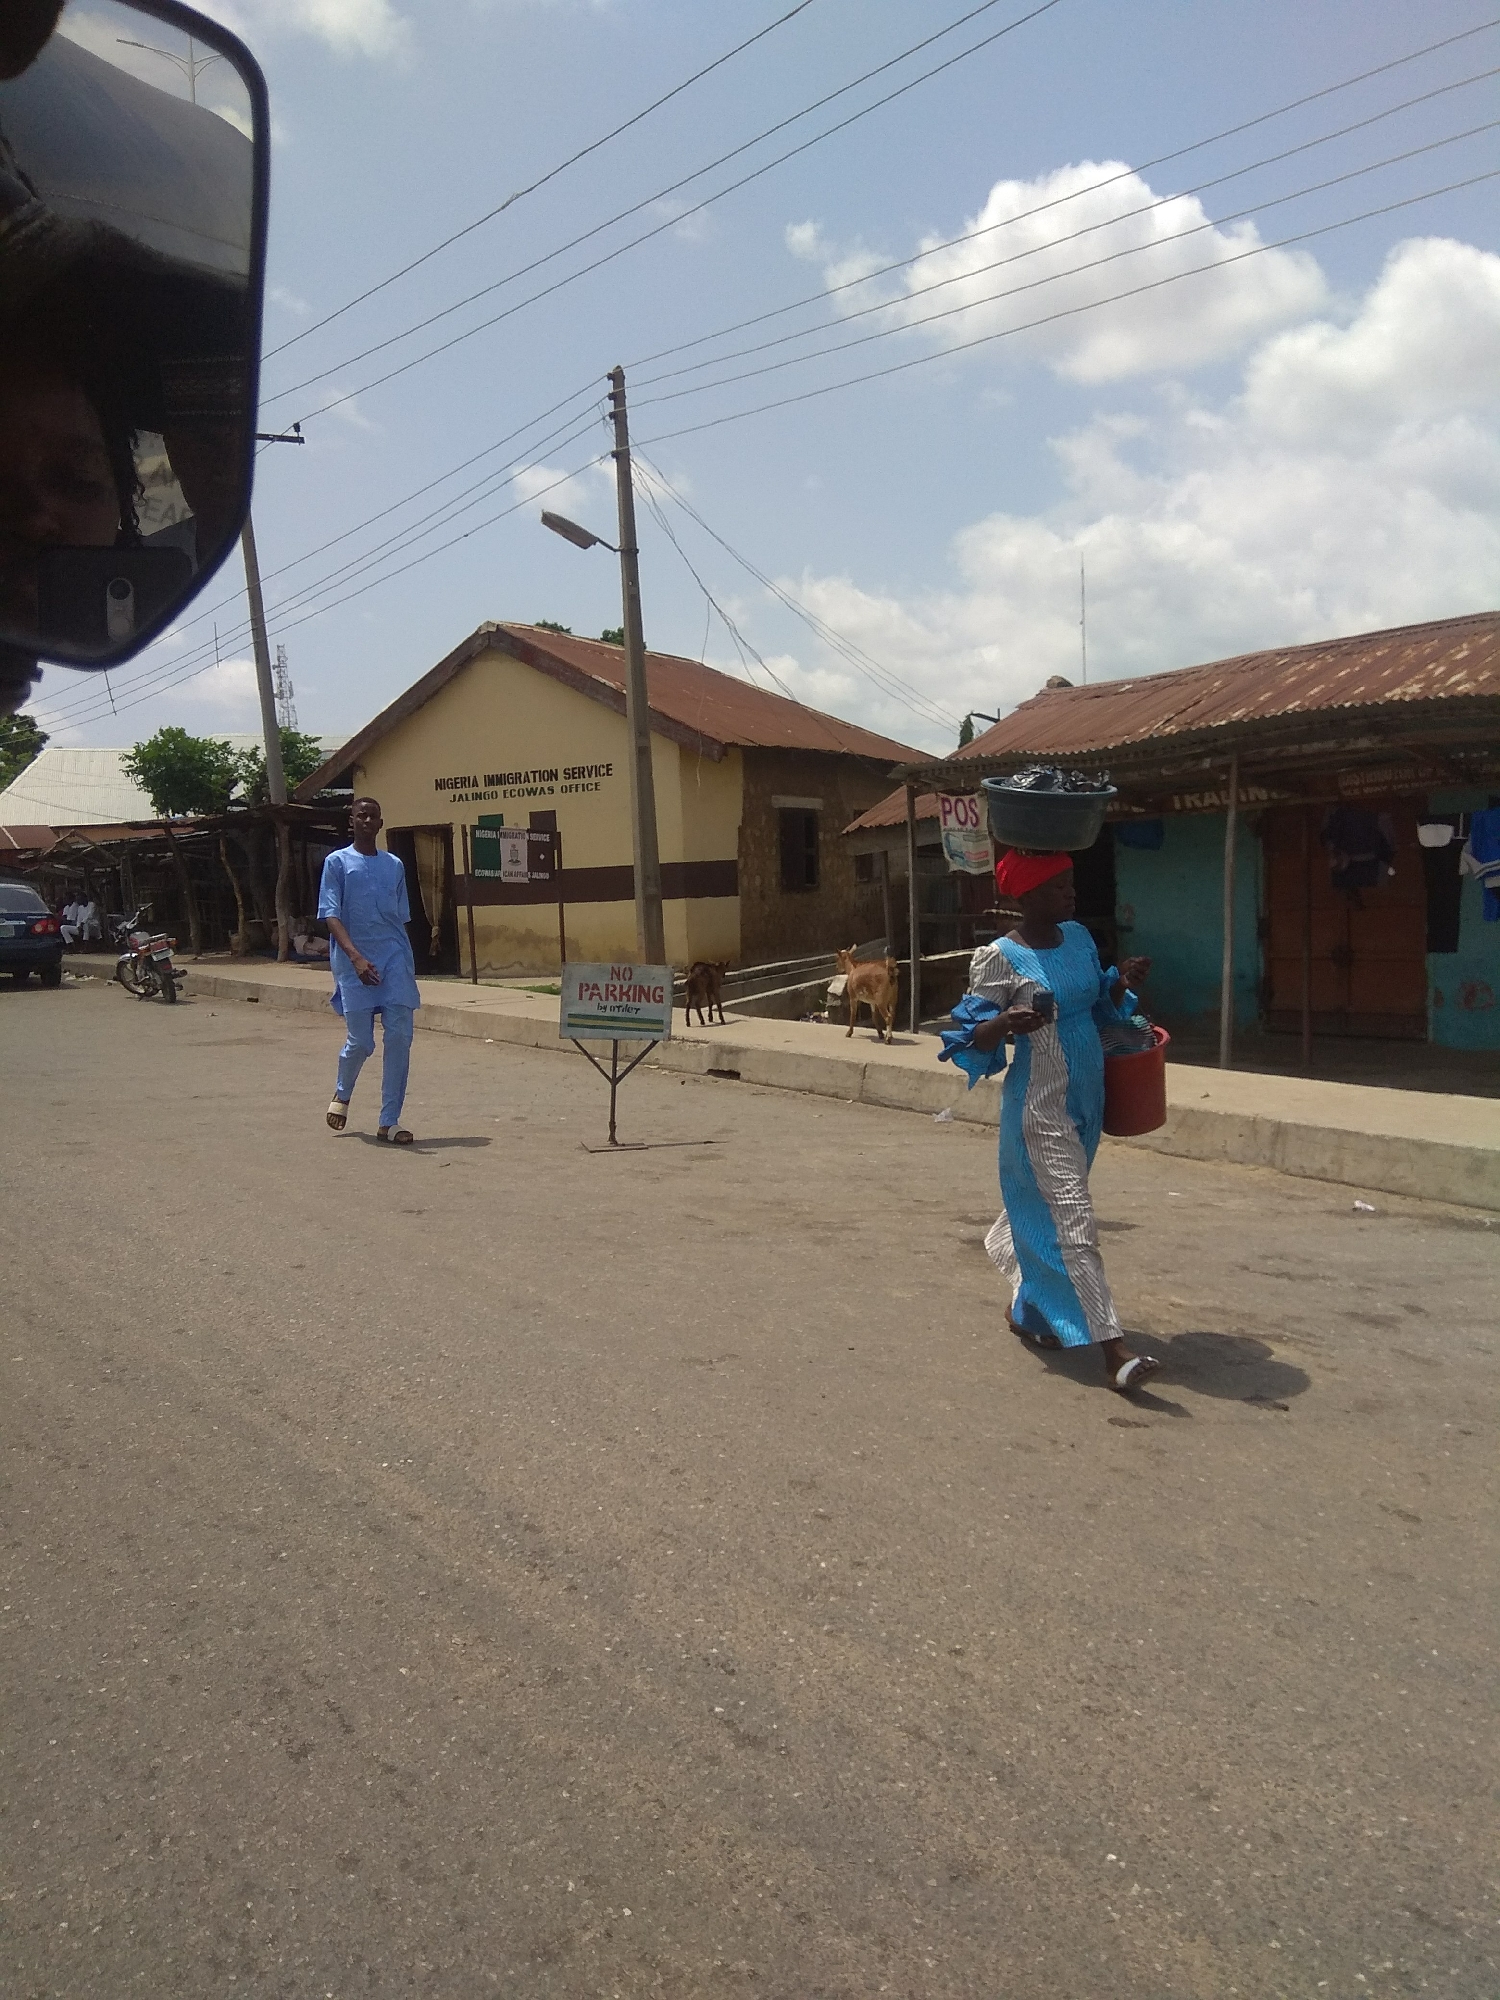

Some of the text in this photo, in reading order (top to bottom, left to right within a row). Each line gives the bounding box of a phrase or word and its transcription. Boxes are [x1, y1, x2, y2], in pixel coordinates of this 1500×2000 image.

[434, 763, 613, 791] NIGERIA IMMIGRATION SERVICE
[449, 781, 601, 803] JALINGO ECOWAS OFFICE
[940, 797, 979, 828] POS
[475, 829, 551, 842] NIGERIA IMMIGRATION SERVICE
[610, 966, 633, 981] NO
[578, 982, 664, 1004] PARKING
[597, 1002, 641, 1014] by order
